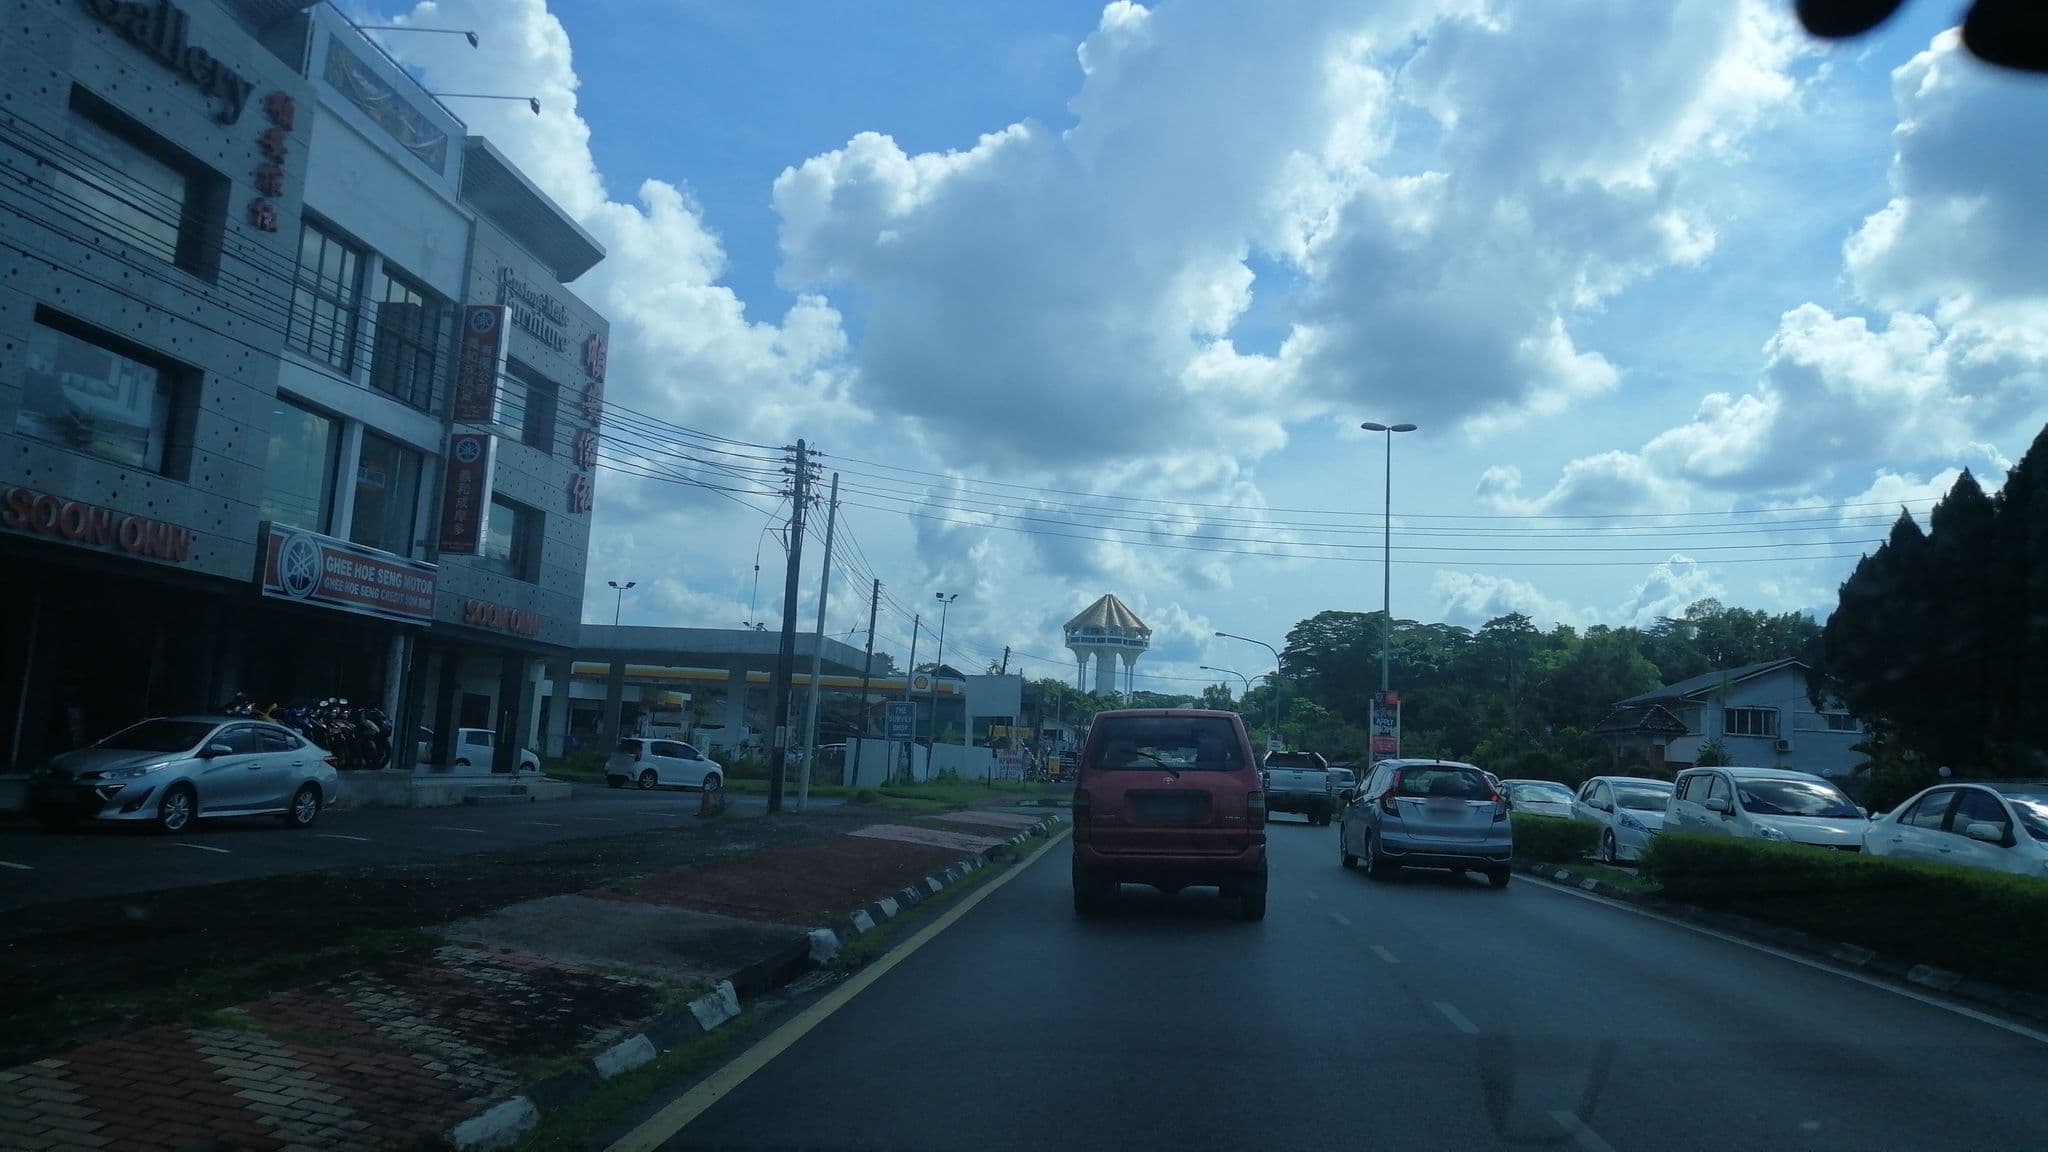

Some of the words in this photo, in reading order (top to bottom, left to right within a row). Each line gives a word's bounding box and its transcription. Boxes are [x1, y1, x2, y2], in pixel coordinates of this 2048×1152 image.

[2, 487, 113, 545] SOON
[119, 516, 191, 561] ONN
[324, 577, 344, 592] GHEE
[345, 581, 359, 596] HOE
[360, 585, 379, 599] SENG
[326, 555, 353, 577] GHEE
[355, 563, 376, 583] HOE
[377, 568, 402, 588] SENG
[404, 575, 433, 595] MOTOR
